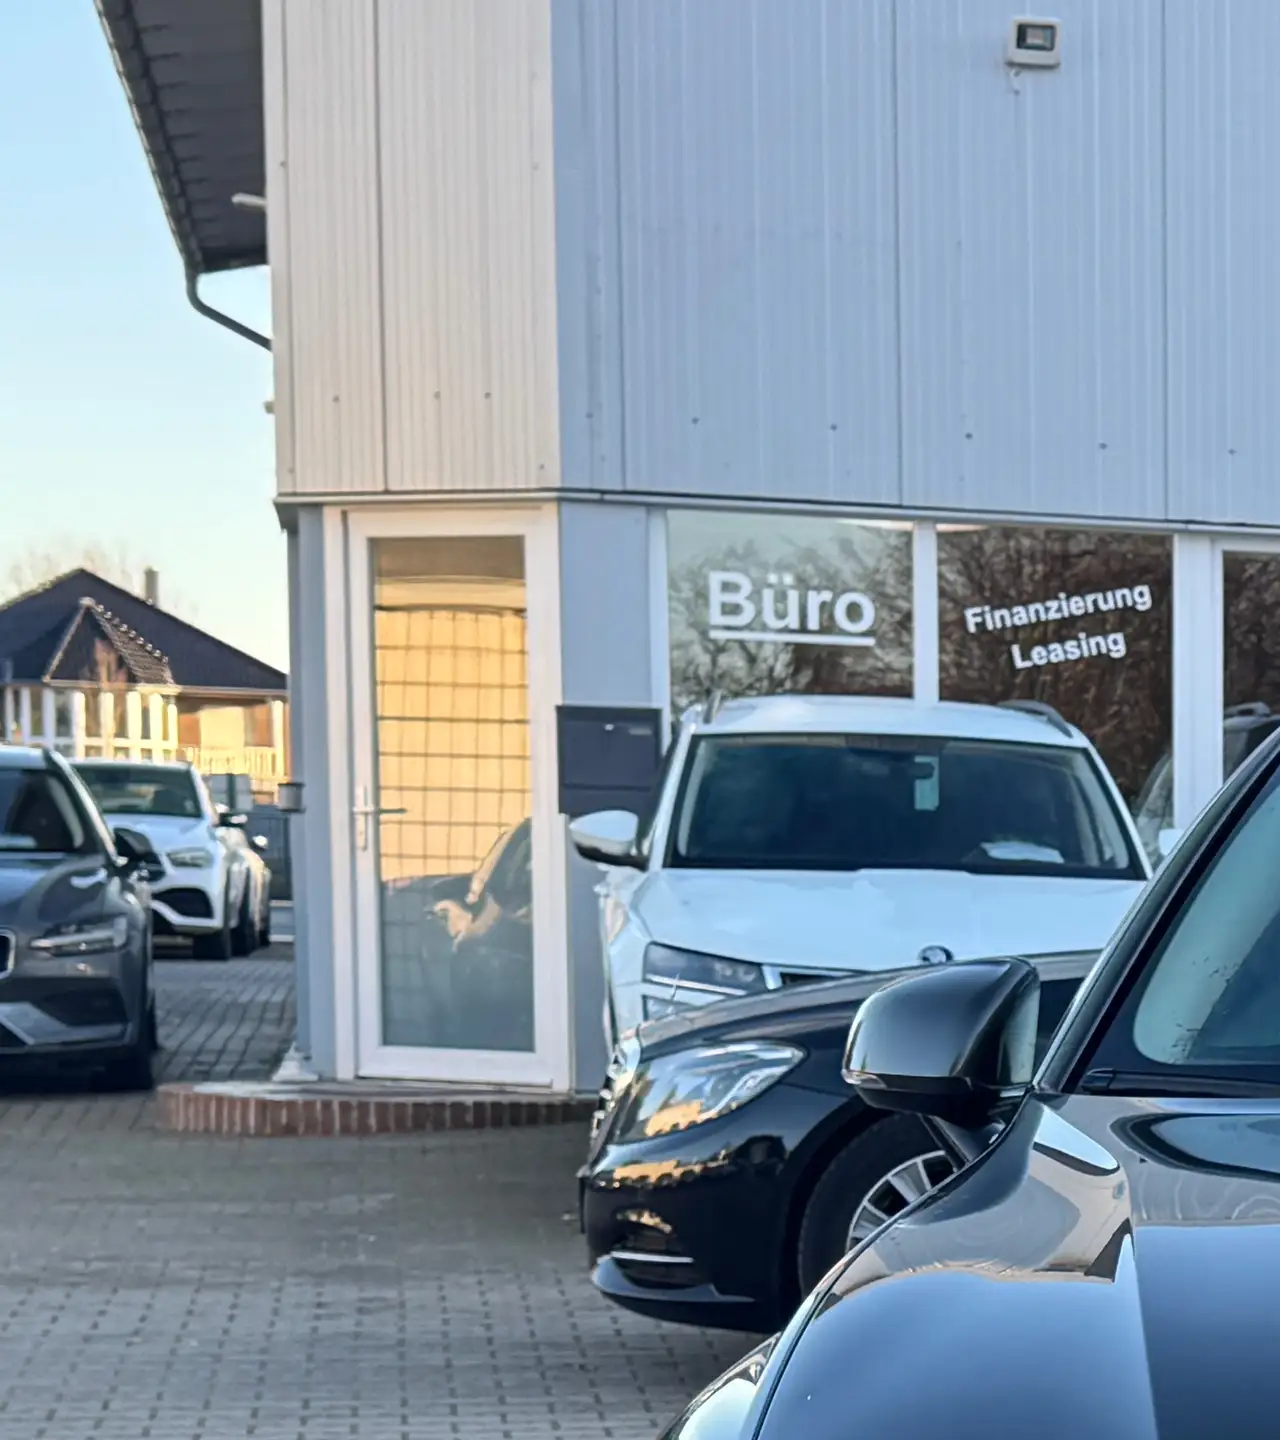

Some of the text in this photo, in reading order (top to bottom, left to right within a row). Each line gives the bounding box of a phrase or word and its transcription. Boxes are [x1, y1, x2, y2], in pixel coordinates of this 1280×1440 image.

[707, 570, 876, 633] Büro
[964, 584, 1152, 634] Finanzierung
[1010, 630, 1127, 670] Leasing
